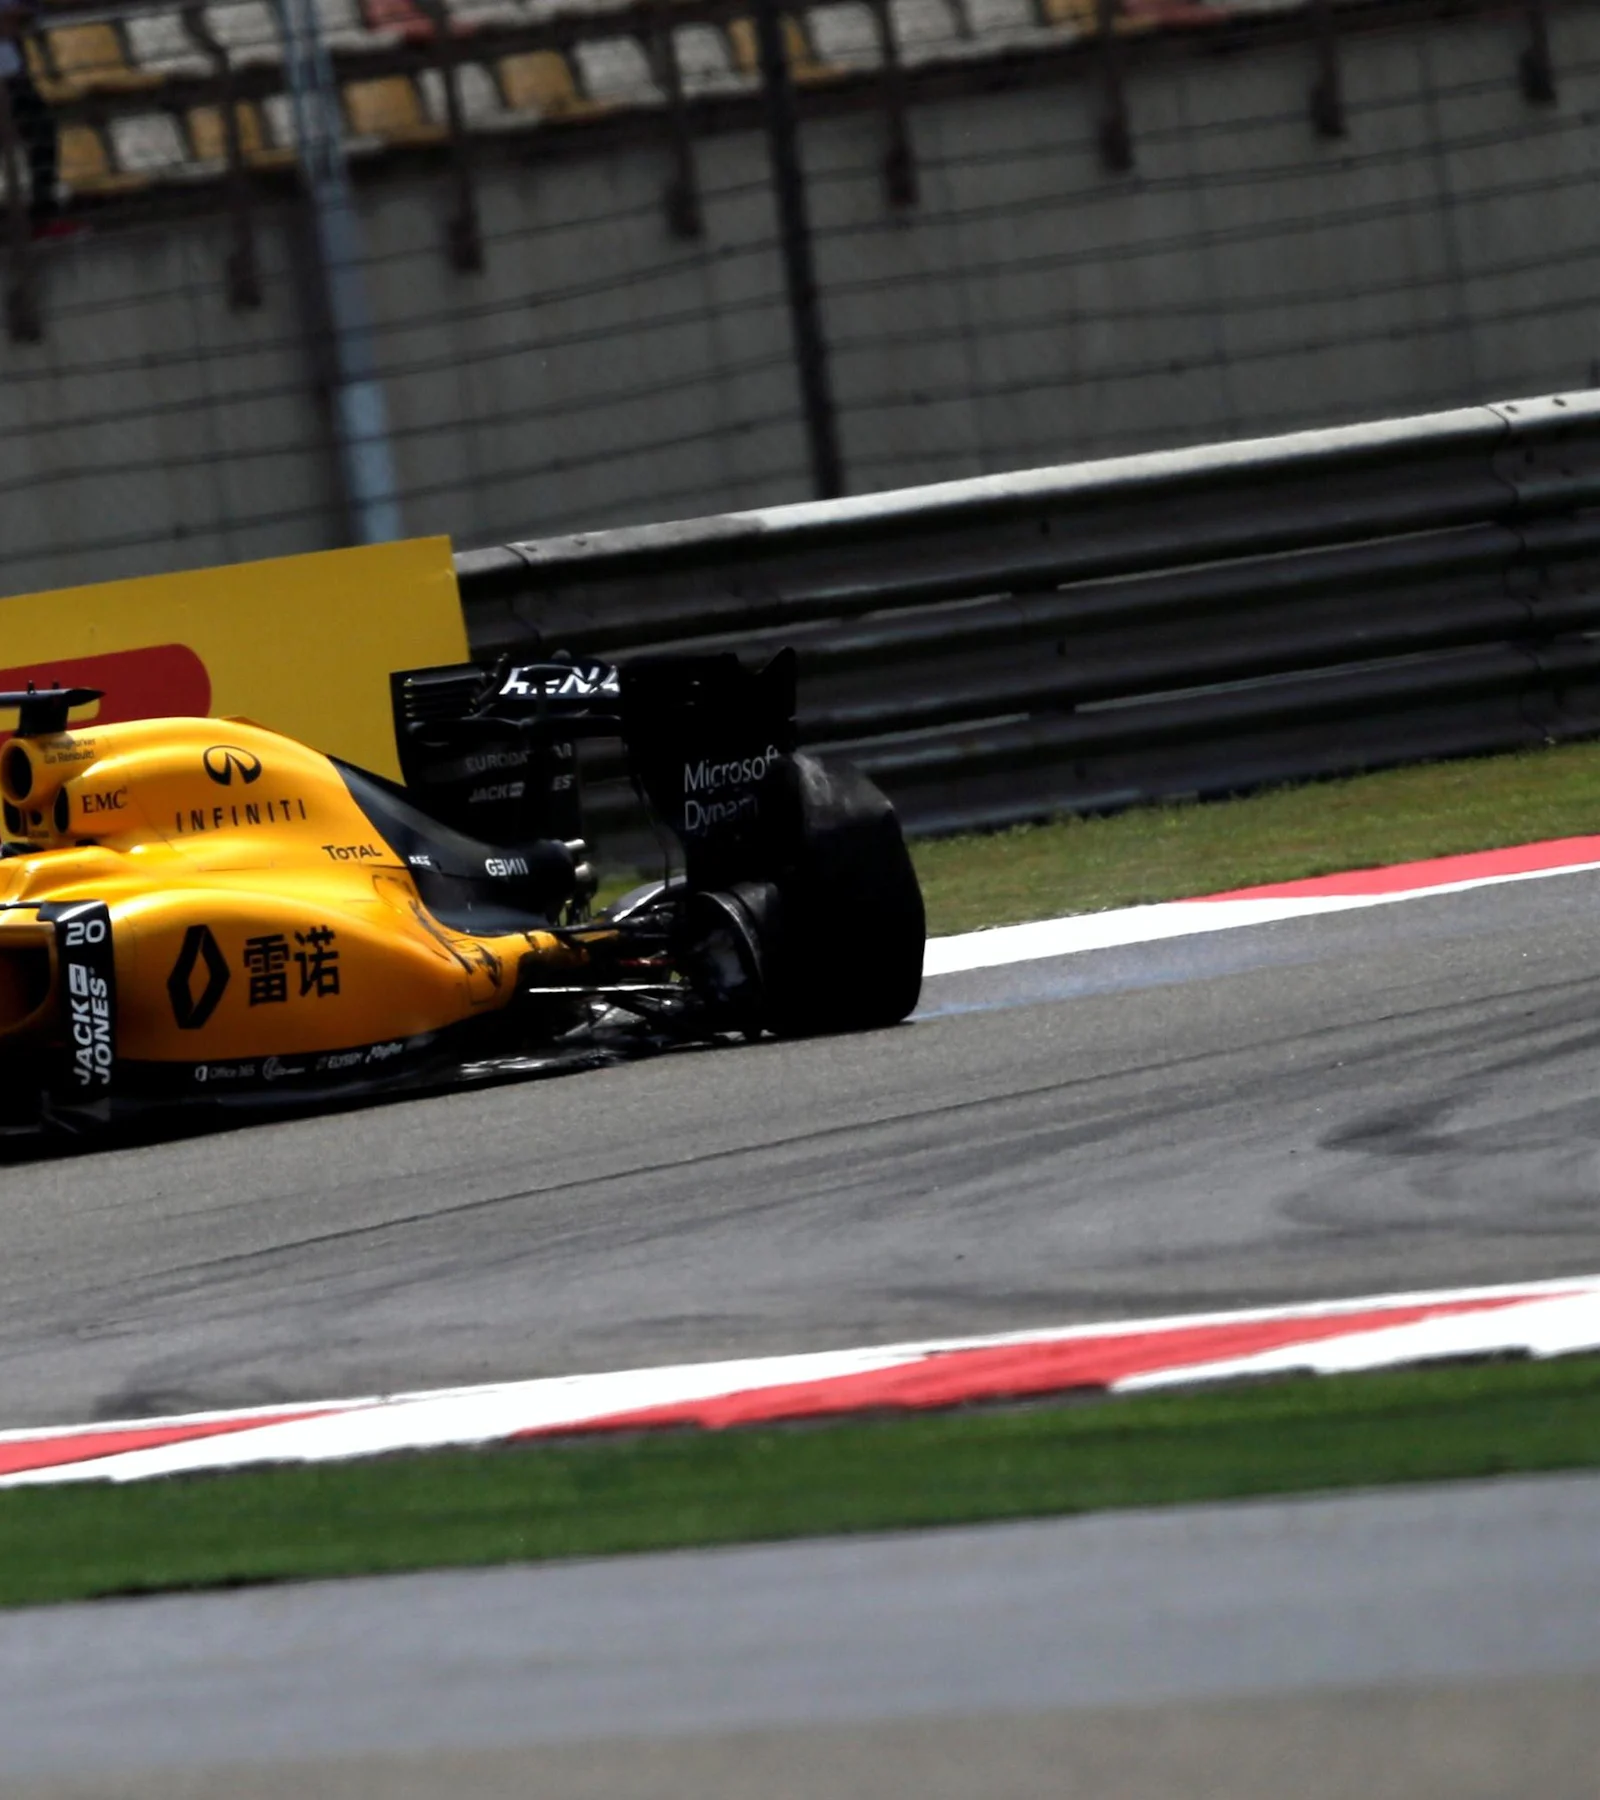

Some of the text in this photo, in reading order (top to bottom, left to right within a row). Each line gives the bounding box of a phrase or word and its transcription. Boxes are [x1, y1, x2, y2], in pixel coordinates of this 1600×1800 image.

[684, 744, 780, 795] Microsoft
[175, 799, 307, 833] INFINITI
[323, 842, 384, 861] TOTAL
[66, 919, 106, 946] 20
[243, 925, 340, 1008] 雷诺
[73, 999, 93, 1086] JACK
[90, 976, 112, 1085] JONES
